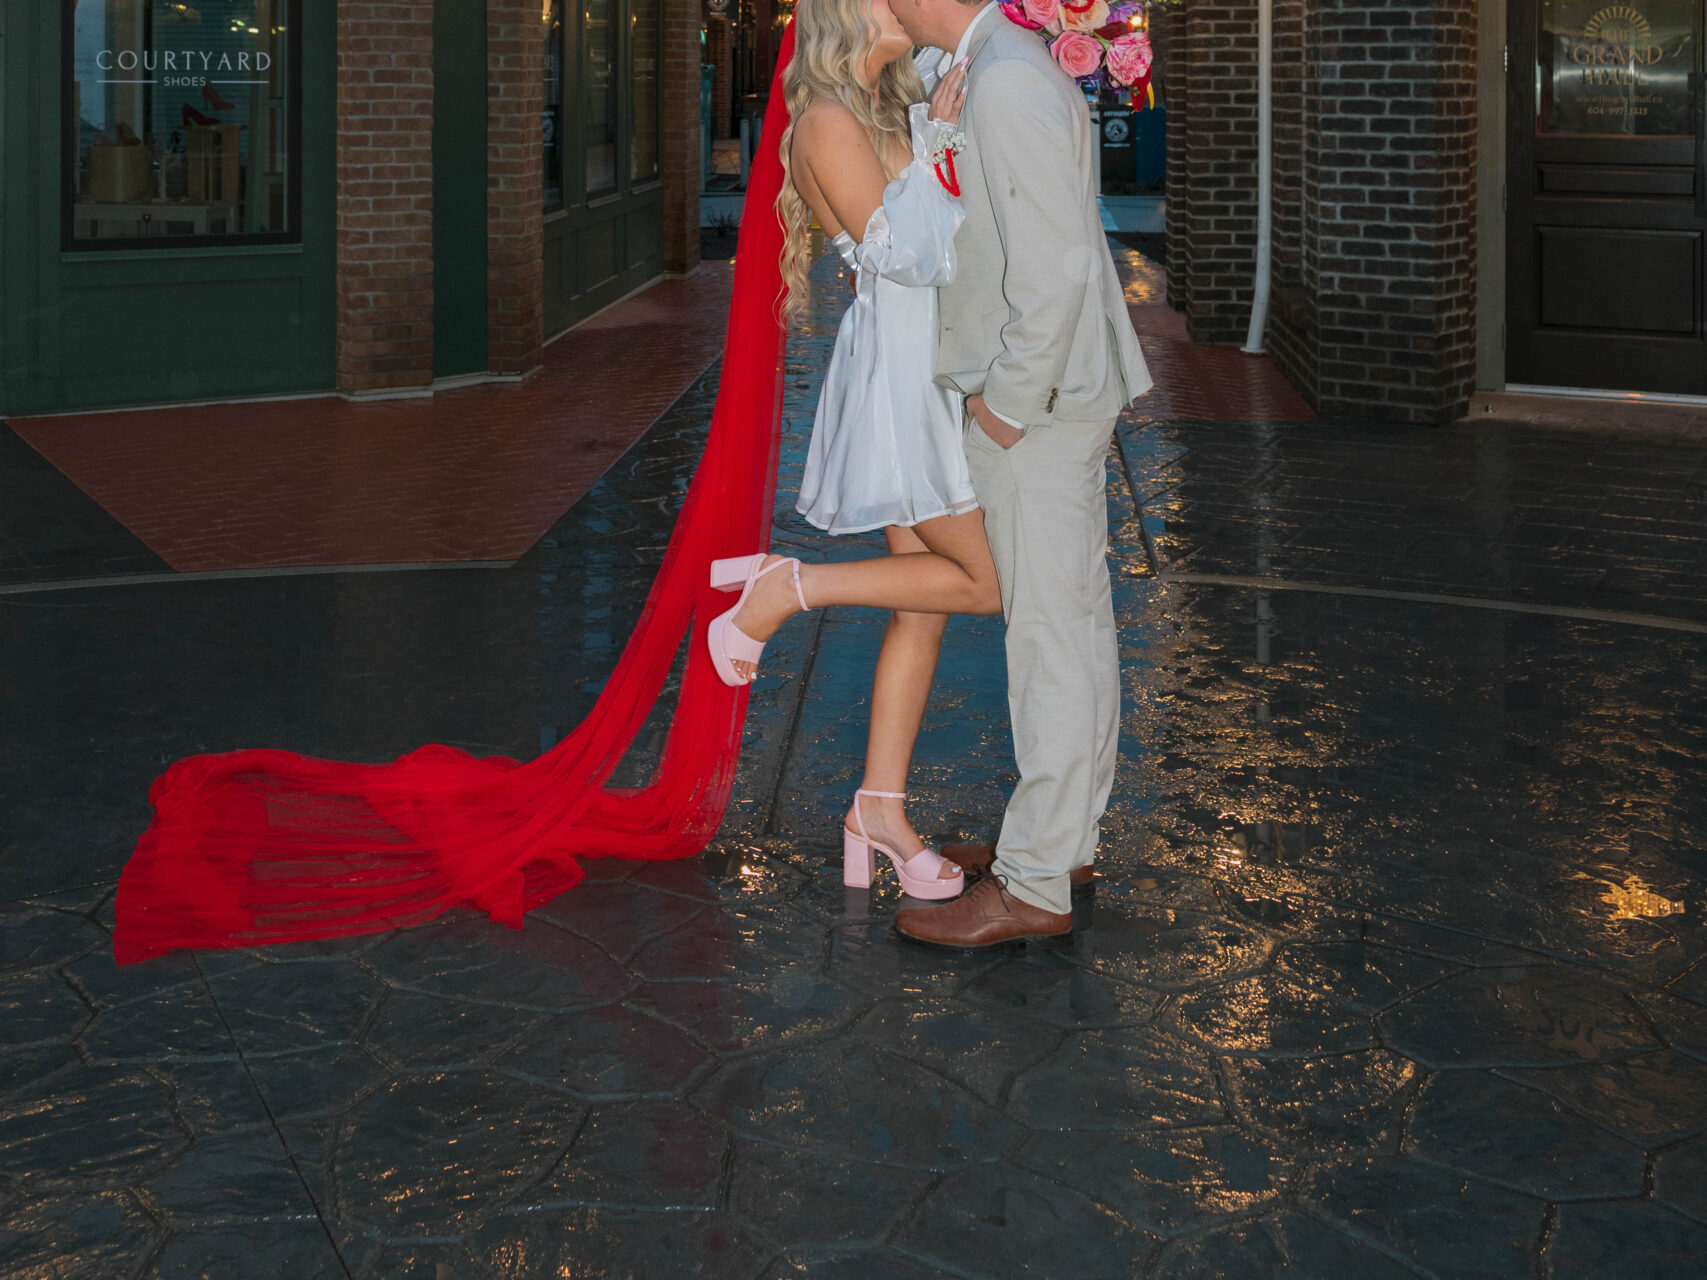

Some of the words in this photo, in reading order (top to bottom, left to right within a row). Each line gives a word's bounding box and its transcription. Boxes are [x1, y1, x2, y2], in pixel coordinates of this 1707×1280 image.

[96, 49, 271, 71] COURTYARD
[1573, 44, 1663, 65] GRAND
[163, 76, 206, 87] SHOES
[1586, 68, 1649, 86] HALL
